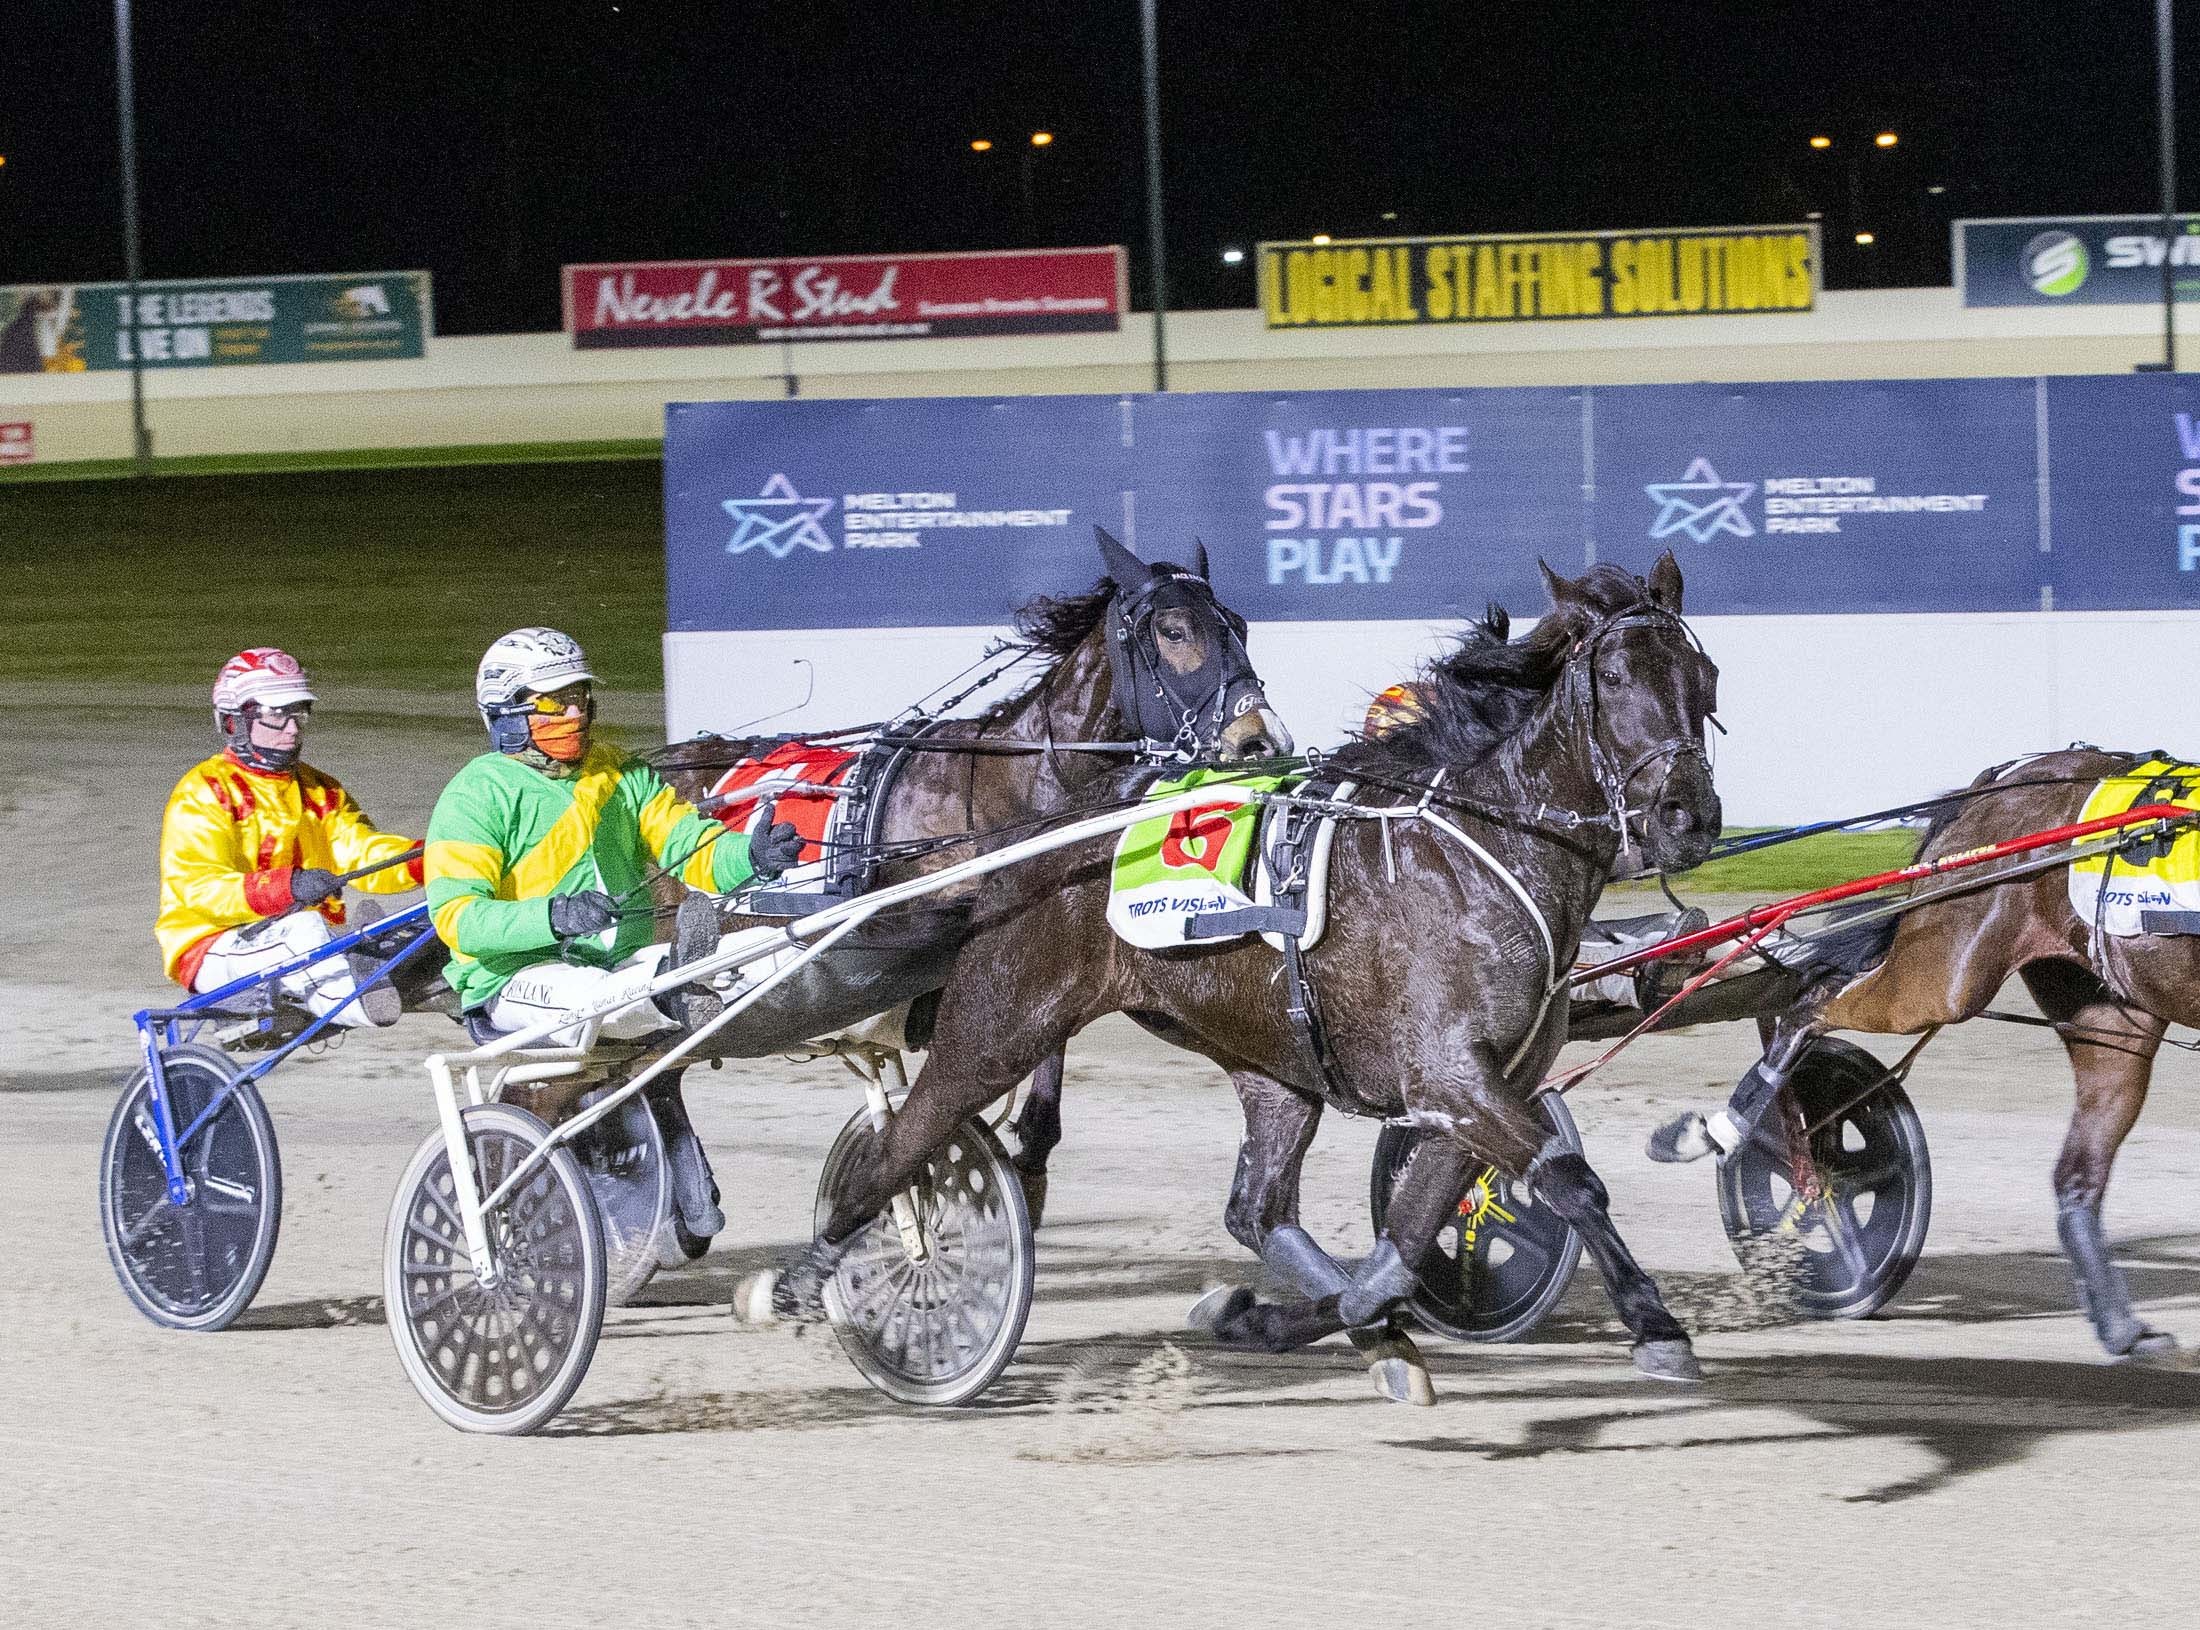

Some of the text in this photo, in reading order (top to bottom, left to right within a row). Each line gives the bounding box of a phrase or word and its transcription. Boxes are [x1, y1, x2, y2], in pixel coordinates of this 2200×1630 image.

[1269, 234, 1810, 323] LOGICAL STAFFING SOLUTIONS
[746, 270, 786, 321] R
[790, 266, 901, 319] Stud
[116, 329, 172, 361] LVE
[1264, 427, 1470, 475] WHERE
[1765, 477, 1876, 495] MELTON
[843, 492, 957, 510] MELTON
[1264, 481, 1442, 530] STARS
[1765, 495, 1989, 514] ENTERTAINMENT
[844, 510, 1073, 530] ENTERTAINMENT
[1765, 516, 1841, 534] PARK
[844, 531, 922, 549] PARK
[1267, 537, 1403, 584] PLAY
[1128, 897, 1168, 919] TROTS
[2096, 890, 2134, 906] OTS
